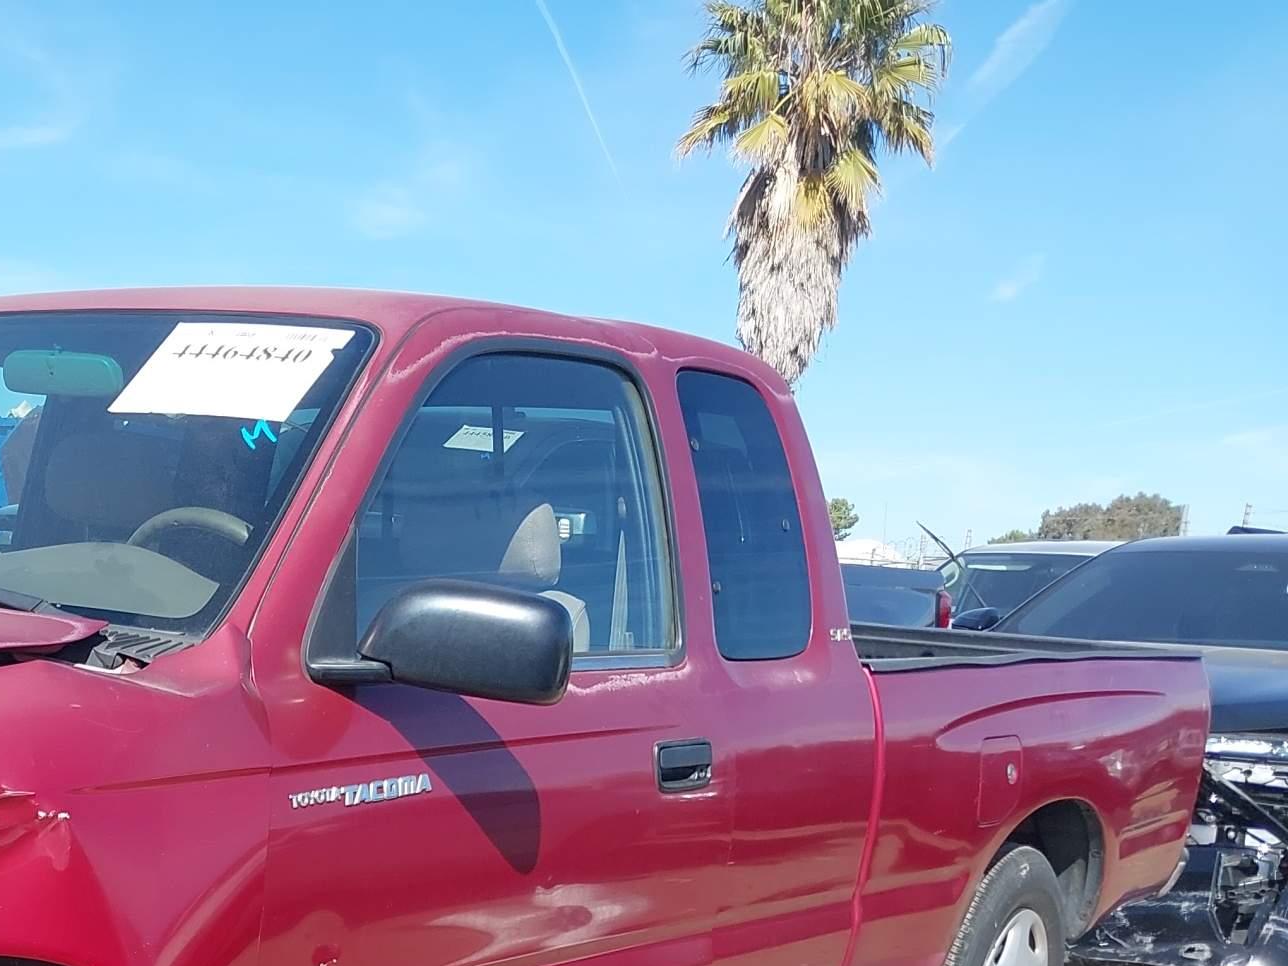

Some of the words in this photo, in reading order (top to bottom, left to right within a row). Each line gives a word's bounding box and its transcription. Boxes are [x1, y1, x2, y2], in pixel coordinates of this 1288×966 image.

[171, 343, 313, 364] 44464840
[289, 786, 343, 809] TOYOTA
[343, 773, 432, 807] TACOMA
